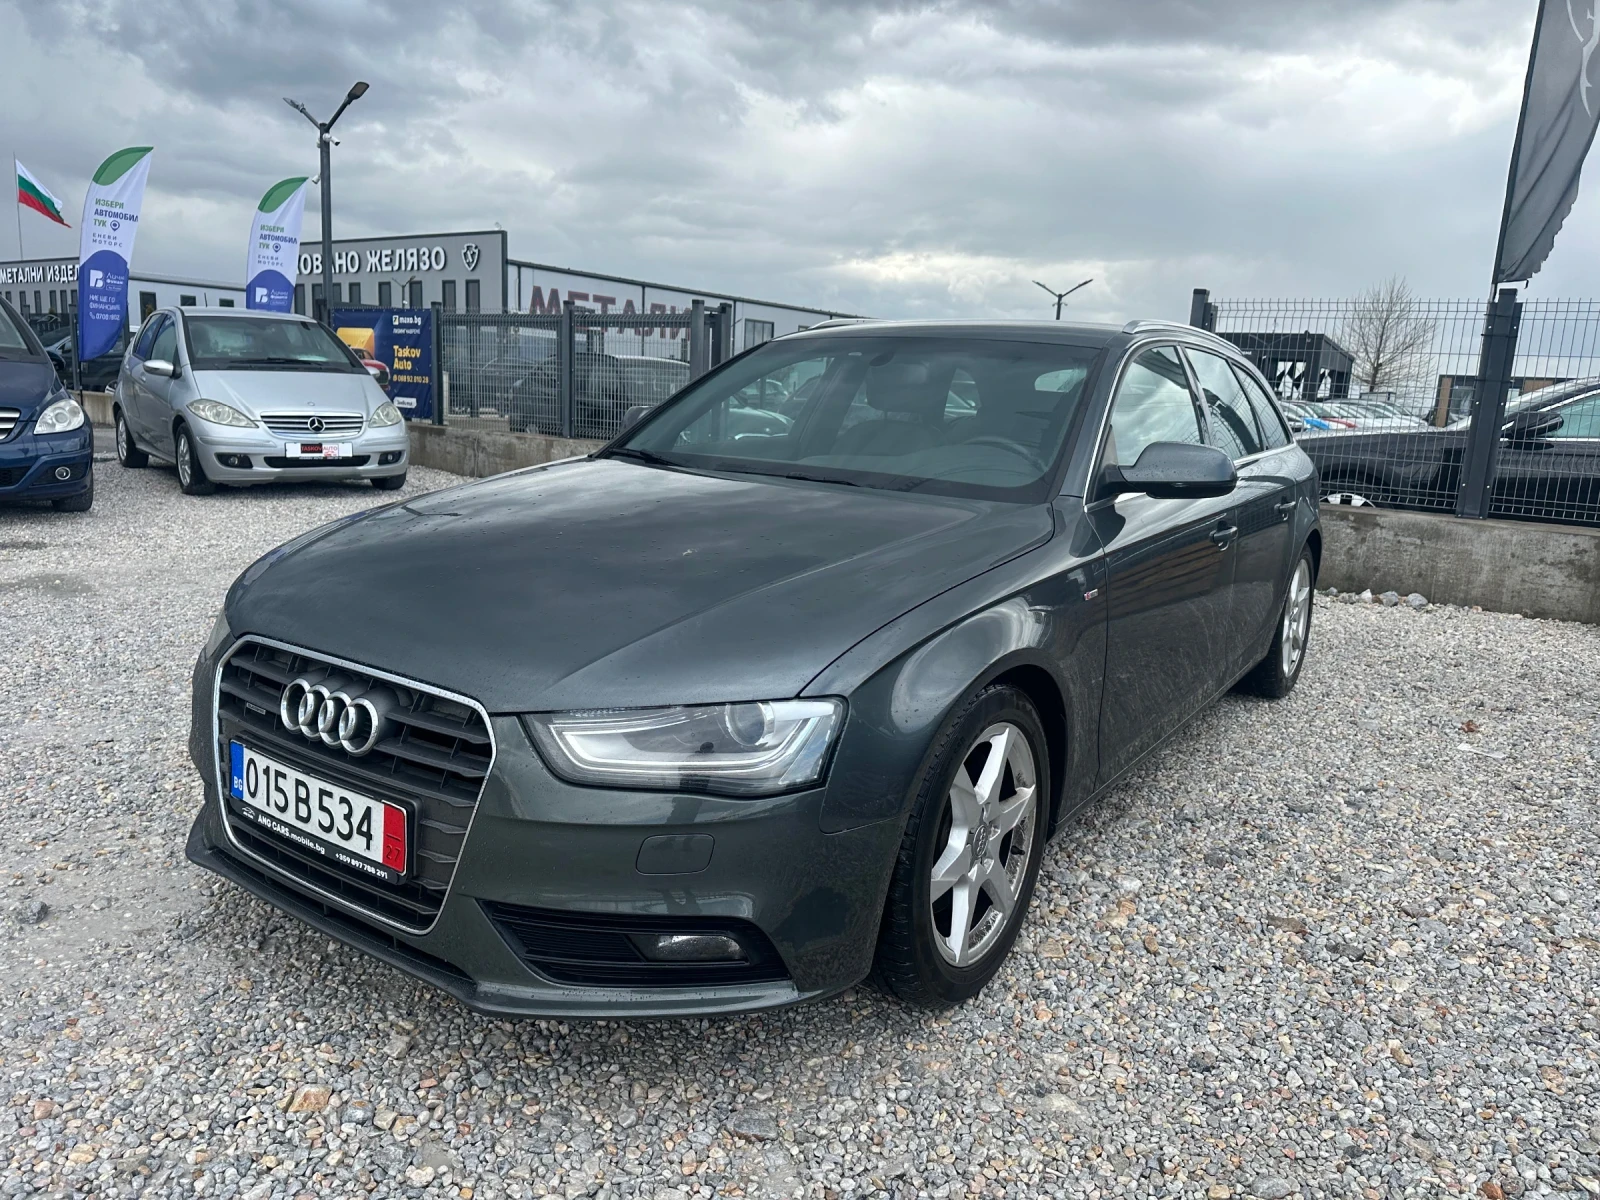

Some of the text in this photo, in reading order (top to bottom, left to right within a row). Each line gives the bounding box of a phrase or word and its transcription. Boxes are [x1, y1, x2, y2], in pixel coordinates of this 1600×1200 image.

[95, 198, 125, 209] ИЗБЕРИ
[94, 208, 139, 222] АВТОМОБИЛ
[93, 218, 107, 227] ТУК
[92, 238, 123, 248] МОТОРС
[296, 246, 446, 275] ОВНО ЖЕЛЯЗО
[0, 266, 44, 284] МЕТАЛНИ
[393, 345, 421, 358] Taskov
[393, 357, 412, 371] Auto
[233, 775, 243, 791] BG
